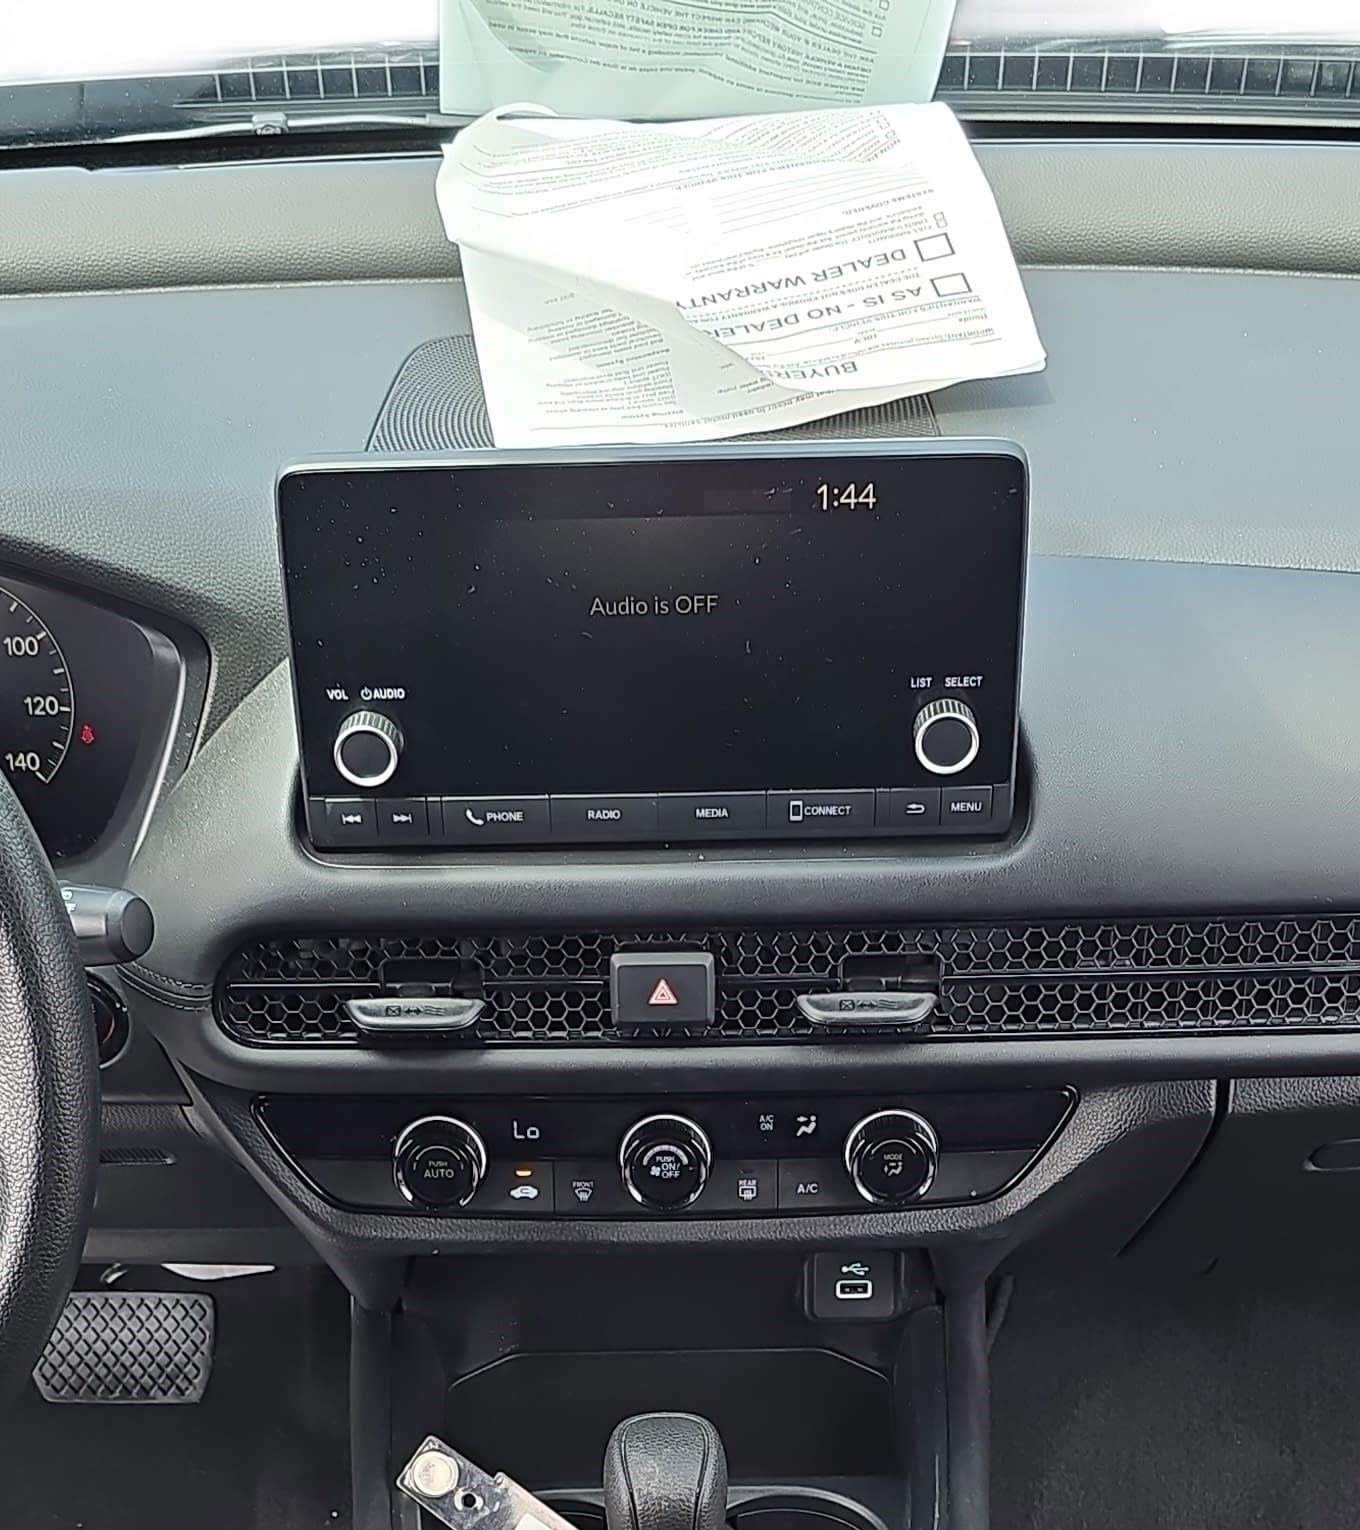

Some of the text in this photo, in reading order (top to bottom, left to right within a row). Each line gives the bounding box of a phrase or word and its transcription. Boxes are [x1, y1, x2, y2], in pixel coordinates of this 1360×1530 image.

[676, 249, 907, 310] DEALER WARRANTY
[862, 294, 885, 307] IS
[891, 286, 922, 301] AS
[808, 305, 842, 319] NO
[703, 313, 800, 338] DEALER
[817, 483, 877, 511] 1:44
[589, 594, 719, 615] Audio is OFF
[3, 636, 39, 657] 100
[910, 677, 933, 688] LIST
[944, 676, 983, 688] SELECT
[326, 689, 348, 701] VOL
[372, 688, 406, 700] AUDIO
[24, 697, 59, 716] 120
[5, 752, 40, 772] 140
[695, 806, 729, 820] MEDIA
[803, 804, 852, 819] CONNECT
[950, 800, 983, 814] MENU
[486, 809, 524, 823] PHONE
[587, 808, 621, 822] RADIO
[759, 1114, 774, 1124] A/C
[512, 1120, 541, 1140] Lo
[759, 1123, 774, 1132] ON
[883, 1153, 904, 1161] MODE
[423, 1169, 455, 1179] AUTO
[661, 1169, 681, 1179] OFF
[797, 1183, 819, 1195] A/C
